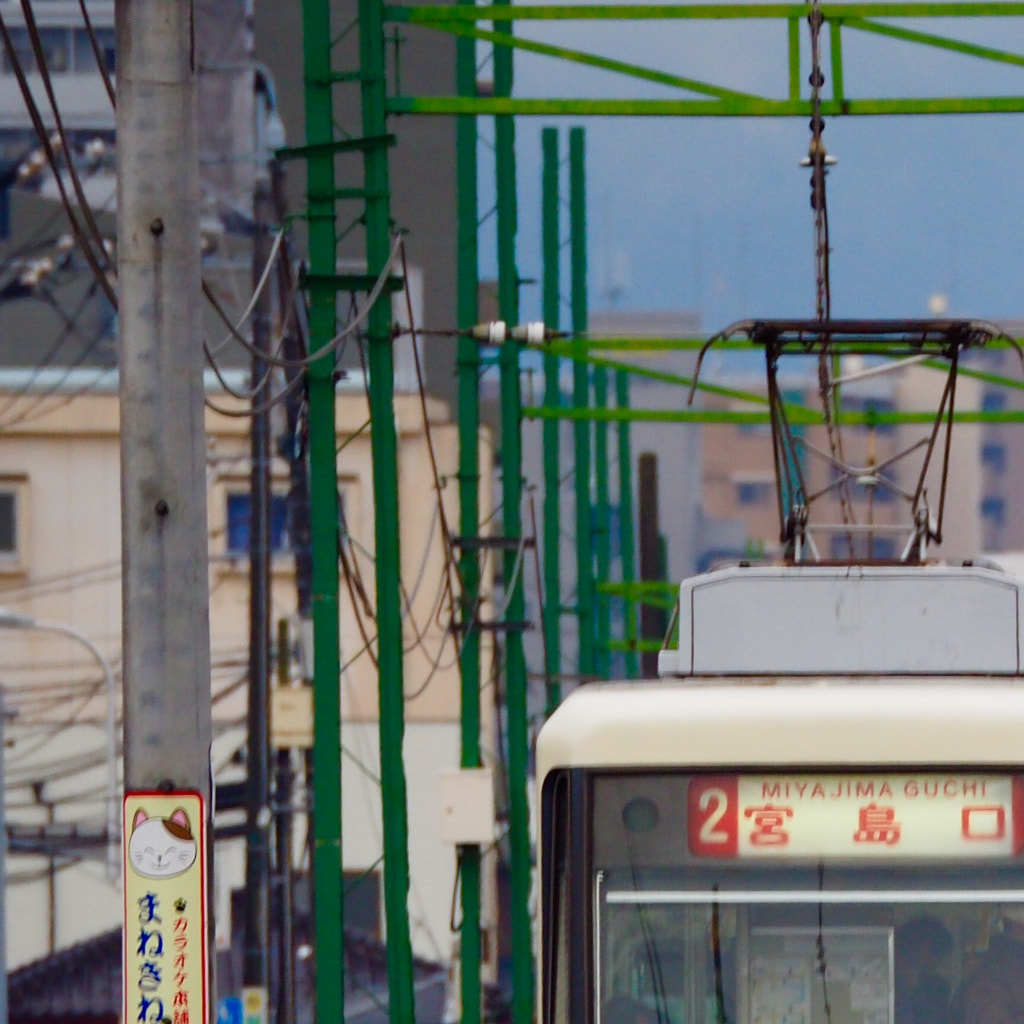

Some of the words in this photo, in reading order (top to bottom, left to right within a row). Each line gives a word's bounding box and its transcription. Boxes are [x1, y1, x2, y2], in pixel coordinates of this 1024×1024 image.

[761, 780, 894, 799] MIYAJIMA
[904, 779, 987, 798] GUCHI
[698, 787, 729, 845] 2
[743, 802, 1006, 847] 宮島口
